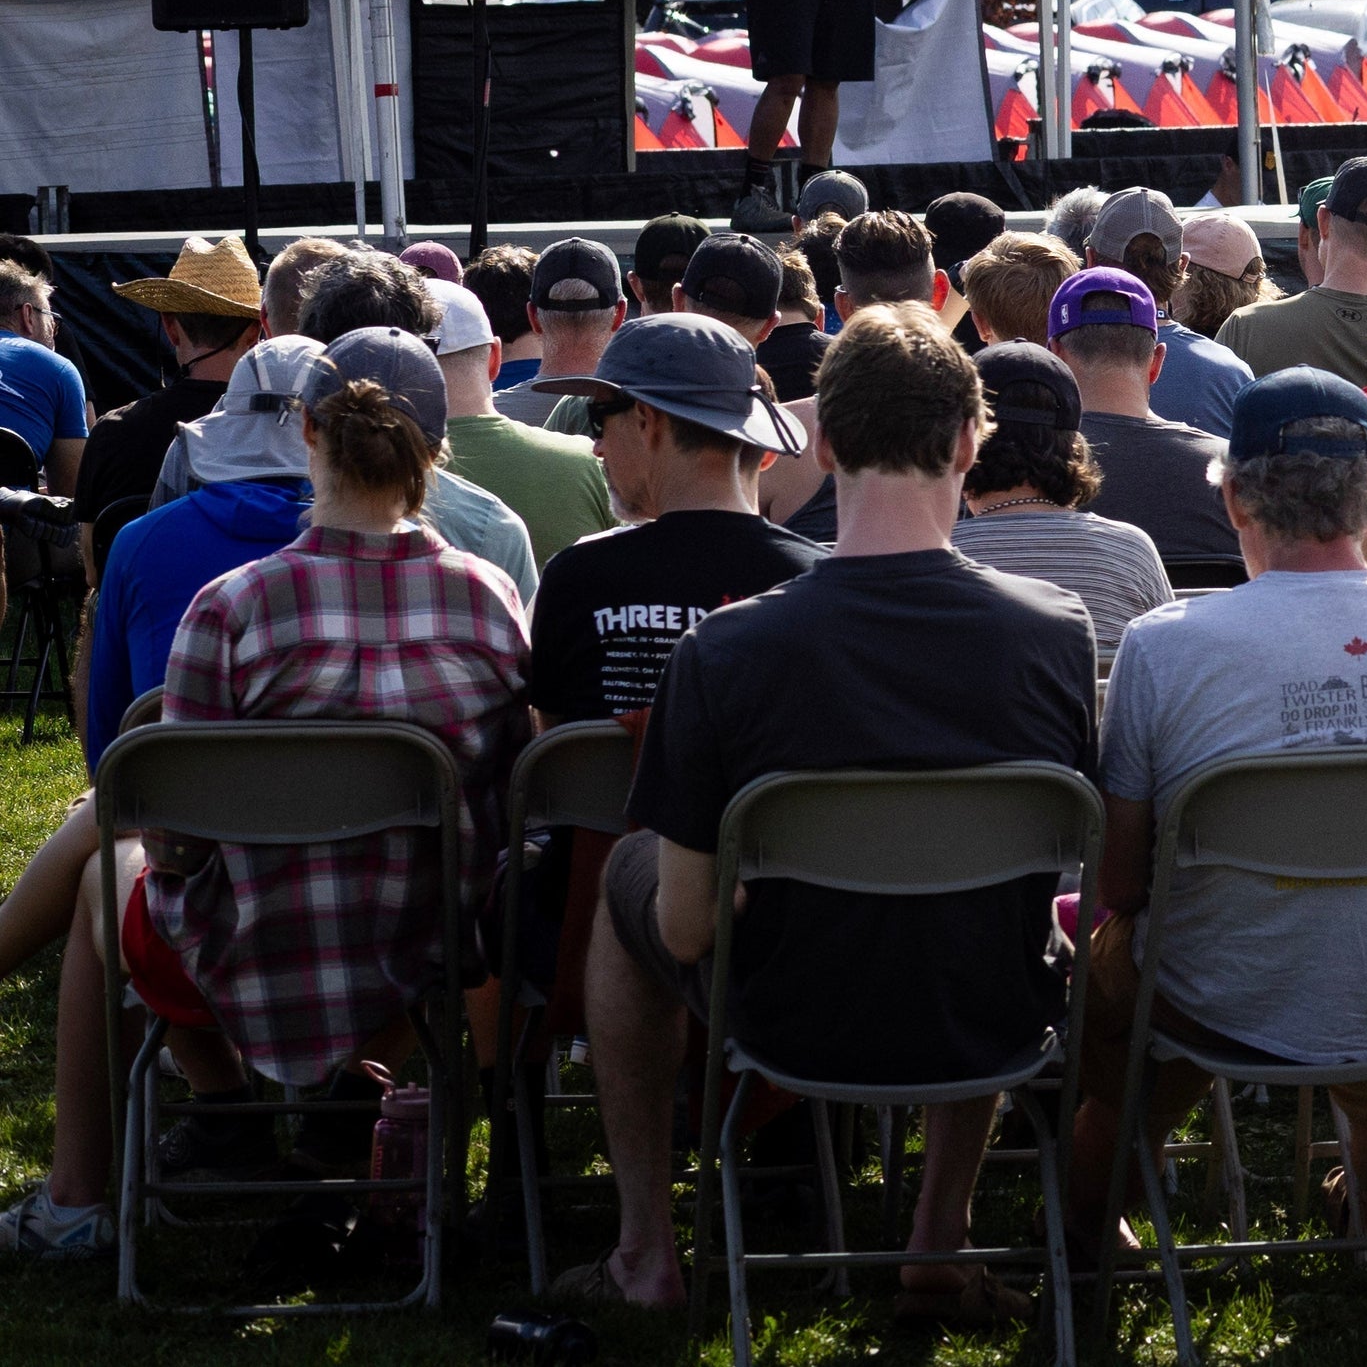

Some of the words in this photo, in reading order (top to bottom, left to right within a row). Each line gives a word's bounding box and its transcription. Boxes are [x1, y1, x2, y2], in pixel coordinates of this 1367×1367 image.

[593, 604, 682, 635] THREE
[1281, 680, 1319, 696] TOAD
[1282, 689, 1357, 708] TWISTER
[1281, 709, 1300, 723] DO
[1303, 704, 1341, 721] DROP
[1343, 702, 1358, 715] IN
